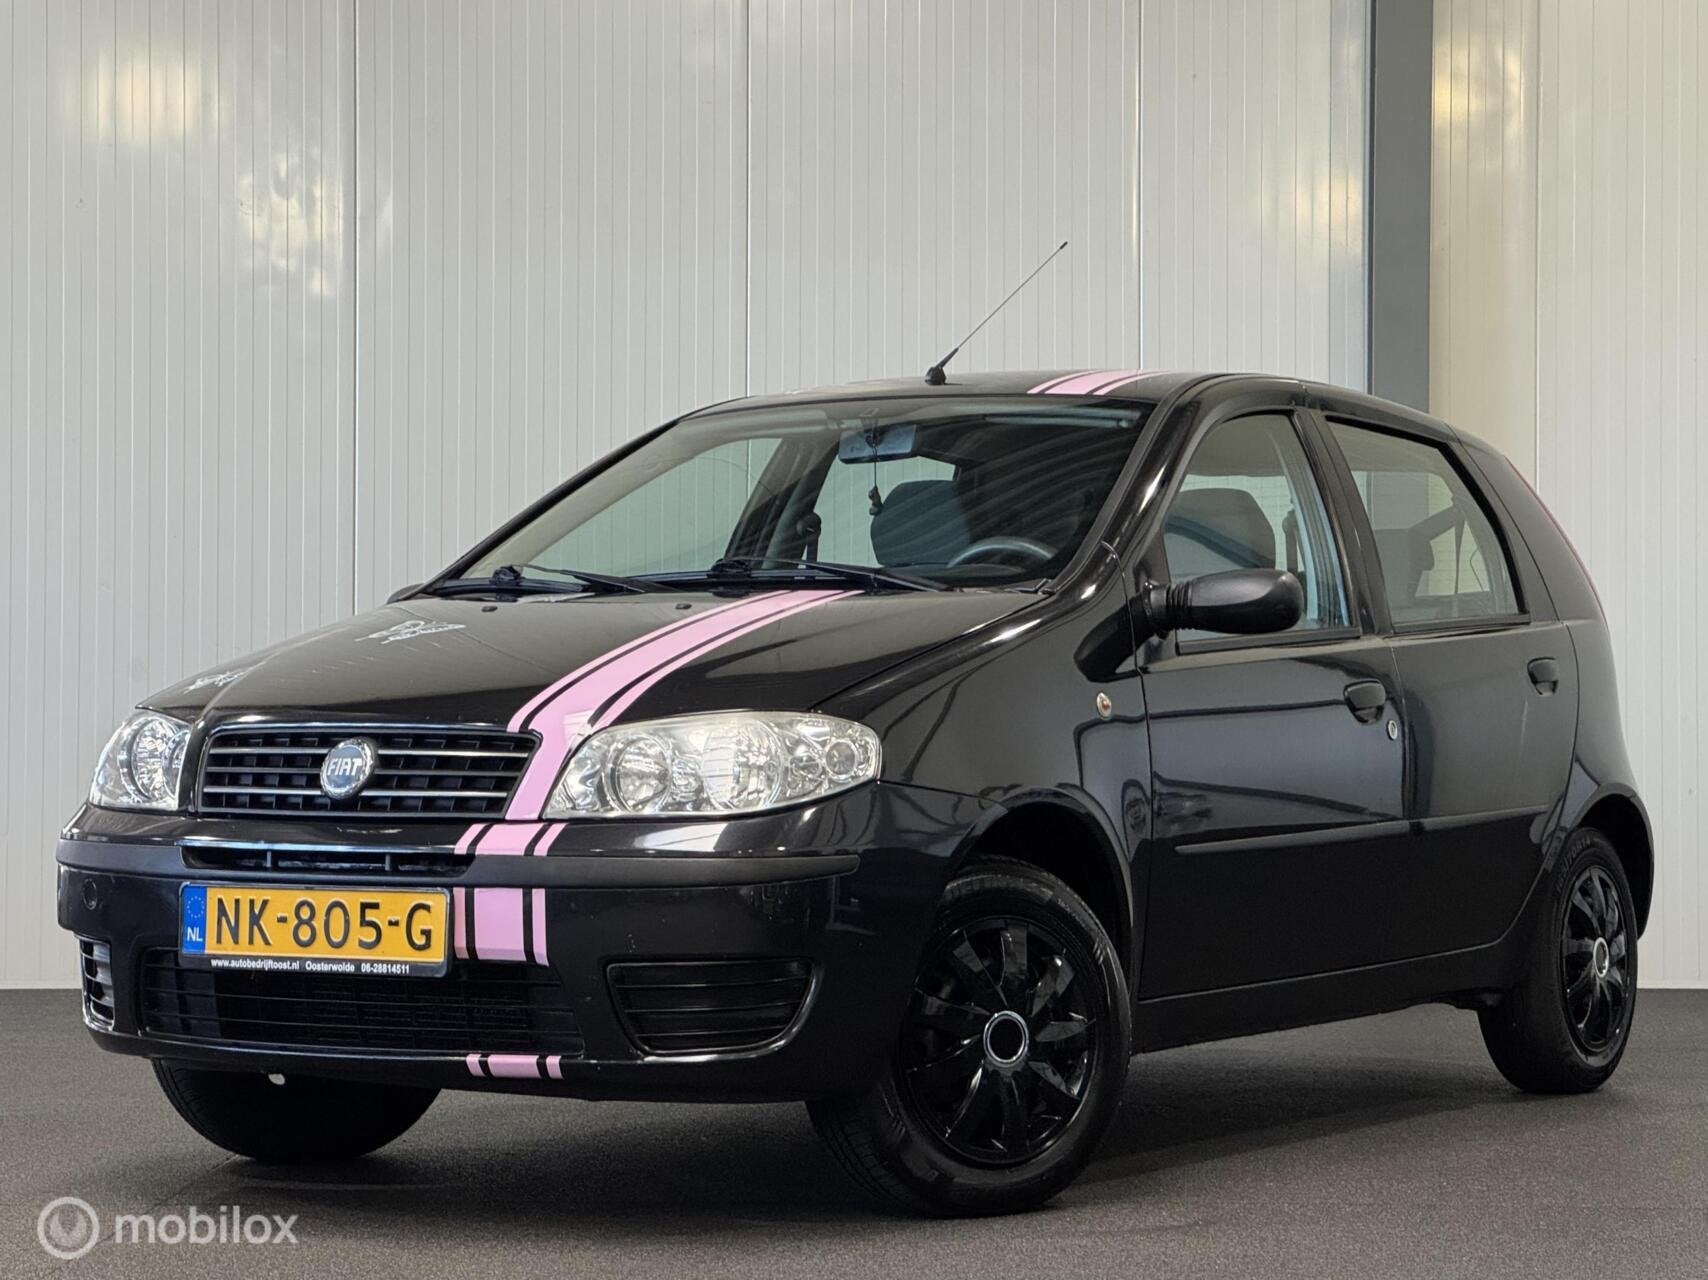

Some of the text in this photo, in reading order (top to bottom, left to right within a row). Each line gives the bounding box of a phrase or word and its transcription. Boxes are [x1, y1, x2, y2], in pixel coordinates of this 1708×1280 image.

[327, 757, 363, 776] FIAT
[215, 896, 433, 951] NK-805-G
[186, 926, 203, 942] NL
[305, 961, 355, 973] Oosterwolde
